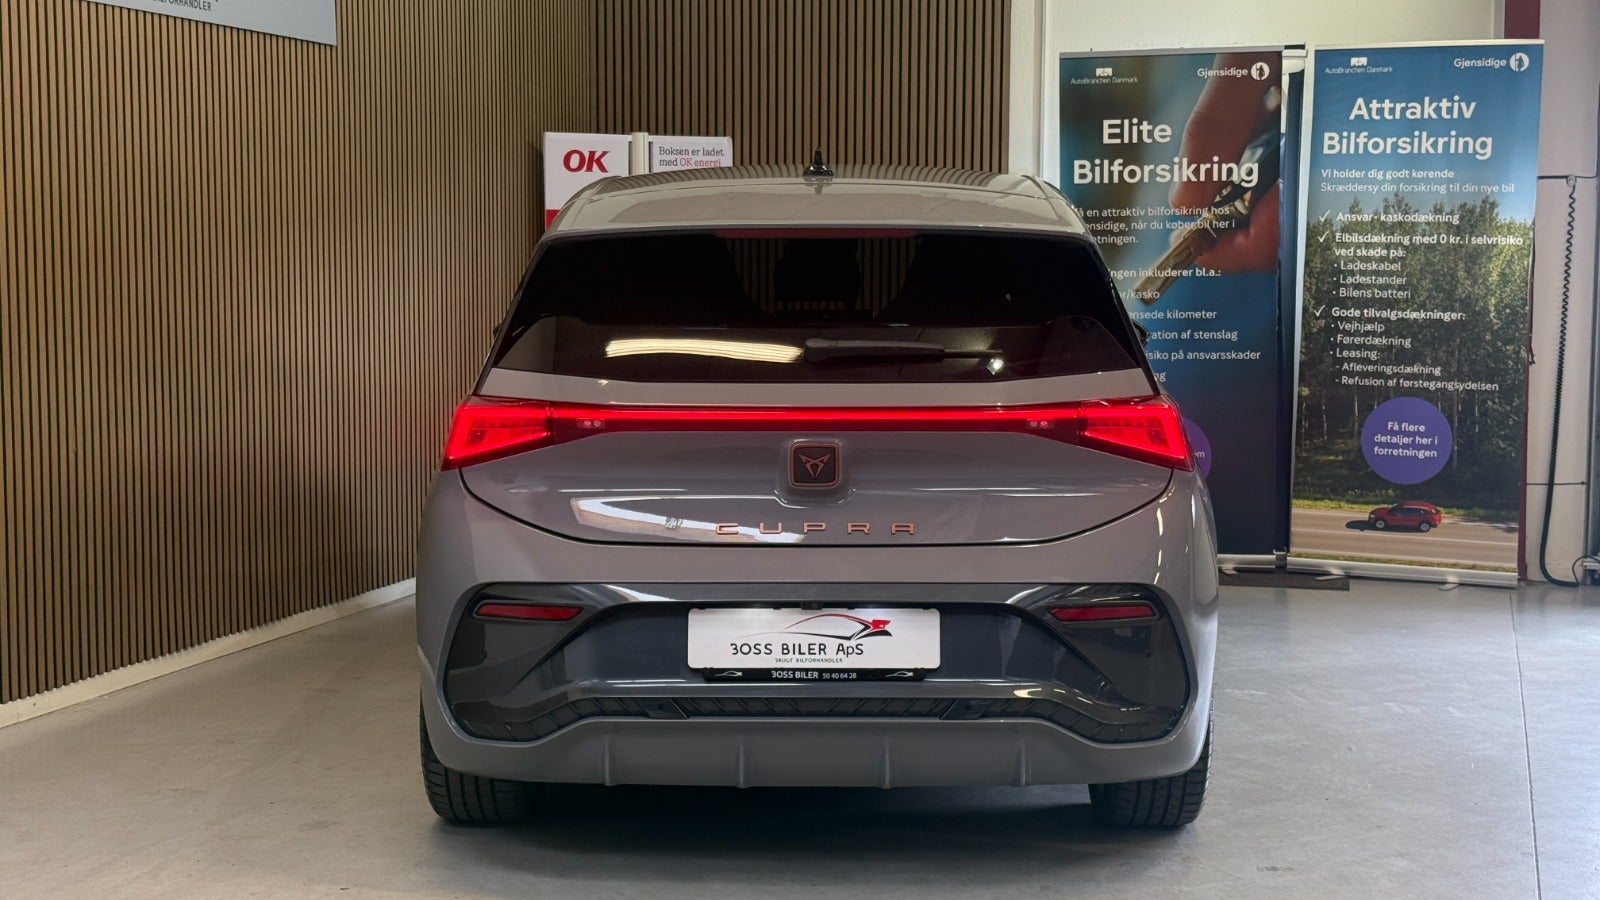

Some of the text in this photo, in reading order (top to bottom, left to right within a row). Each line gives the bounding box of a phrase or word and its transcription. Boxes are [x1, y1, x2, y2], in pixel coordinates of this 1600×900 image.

[1454, 58, 1507, 69] Gjensidige
[1197, 68, 1249, 78] Gjensidige
[1349, 95, 1477, 121] Attraktiv
[1103, 118, 1172, 144] Elite
[659, 147, 689, 156] Boksen
[703, 148, 724, 156] ladet
[1323, 131, 1493, 160] Bilforsikring
[563, 149, 610, 173] OK
[659, 159, 678, 167] med
[680, 158, 693, 167] OK
[1073, 156, 1259, 188] Bilforsikring
[1321, 169, 1455, 181] Vi holder dig godt kørende
[1320, 183, 1515, 195] Skræddersy din forsikring til din nye bil
[1077, 206, 1230, 218] å en attraktiv bilforsikring hos
[1131, 220, 1148, 230] når
[1151, 220, 1163, 229] du
[1166, 220, 1195, 229] køber
[1198, 219, 1210, 229] bil
[1212, 219, 1230, 229] her
[1232, 220, 1235, 228] i
[1336, 212, 1460, 225] Ansvar- kaskodækning
[1335, 233, 1523, 246] Elbilsdækning med 0 kr. i selvrisiko
[1334, 248, 1407, 260] ved skade på:
[1139, 267, 1193, 277] inkluderer
[1196, 268, 1221, 277] bl.a.:
[1340, 261, 1402, 272] Ladeskabel
[1339, 275, 1407, 285] Ladestander
[1339, 288, 1412, 299] Bilens batteri
[1167, 309, 1217, 320] kilometer
[1331, 306, 1467, 322] Gode tilvalgsdækninger:
[1337, 321, 1386, 333] Vejhjælp
[1181, 330, 1191, 340] af
[1194, 330, 1238, 341] stenslag
[1337, 334, 1412, 349] Førerdækning
[1171, 350, 1184, 361] på
[1186, 350, 1262, 360] ansvarsskader
[1336, 348, 1381, 361] Leasing:
[1341, 363, 1442, 377] Afleveringsdækning
[1341, 376, 1500, 392] Refusion af førstegangsydelsen
[1387, 421, 1426, 432] Få flere
[1374, 434, 1438, 446] detaljer her i
[1374, 446, 1438, 459] forretningen
[715, 522, 916, 535] CUPRA
[782, 643, 827, 655] BILER
[836, 643, 864, 658] ApS
[795, 671, 819, 679] BILER
